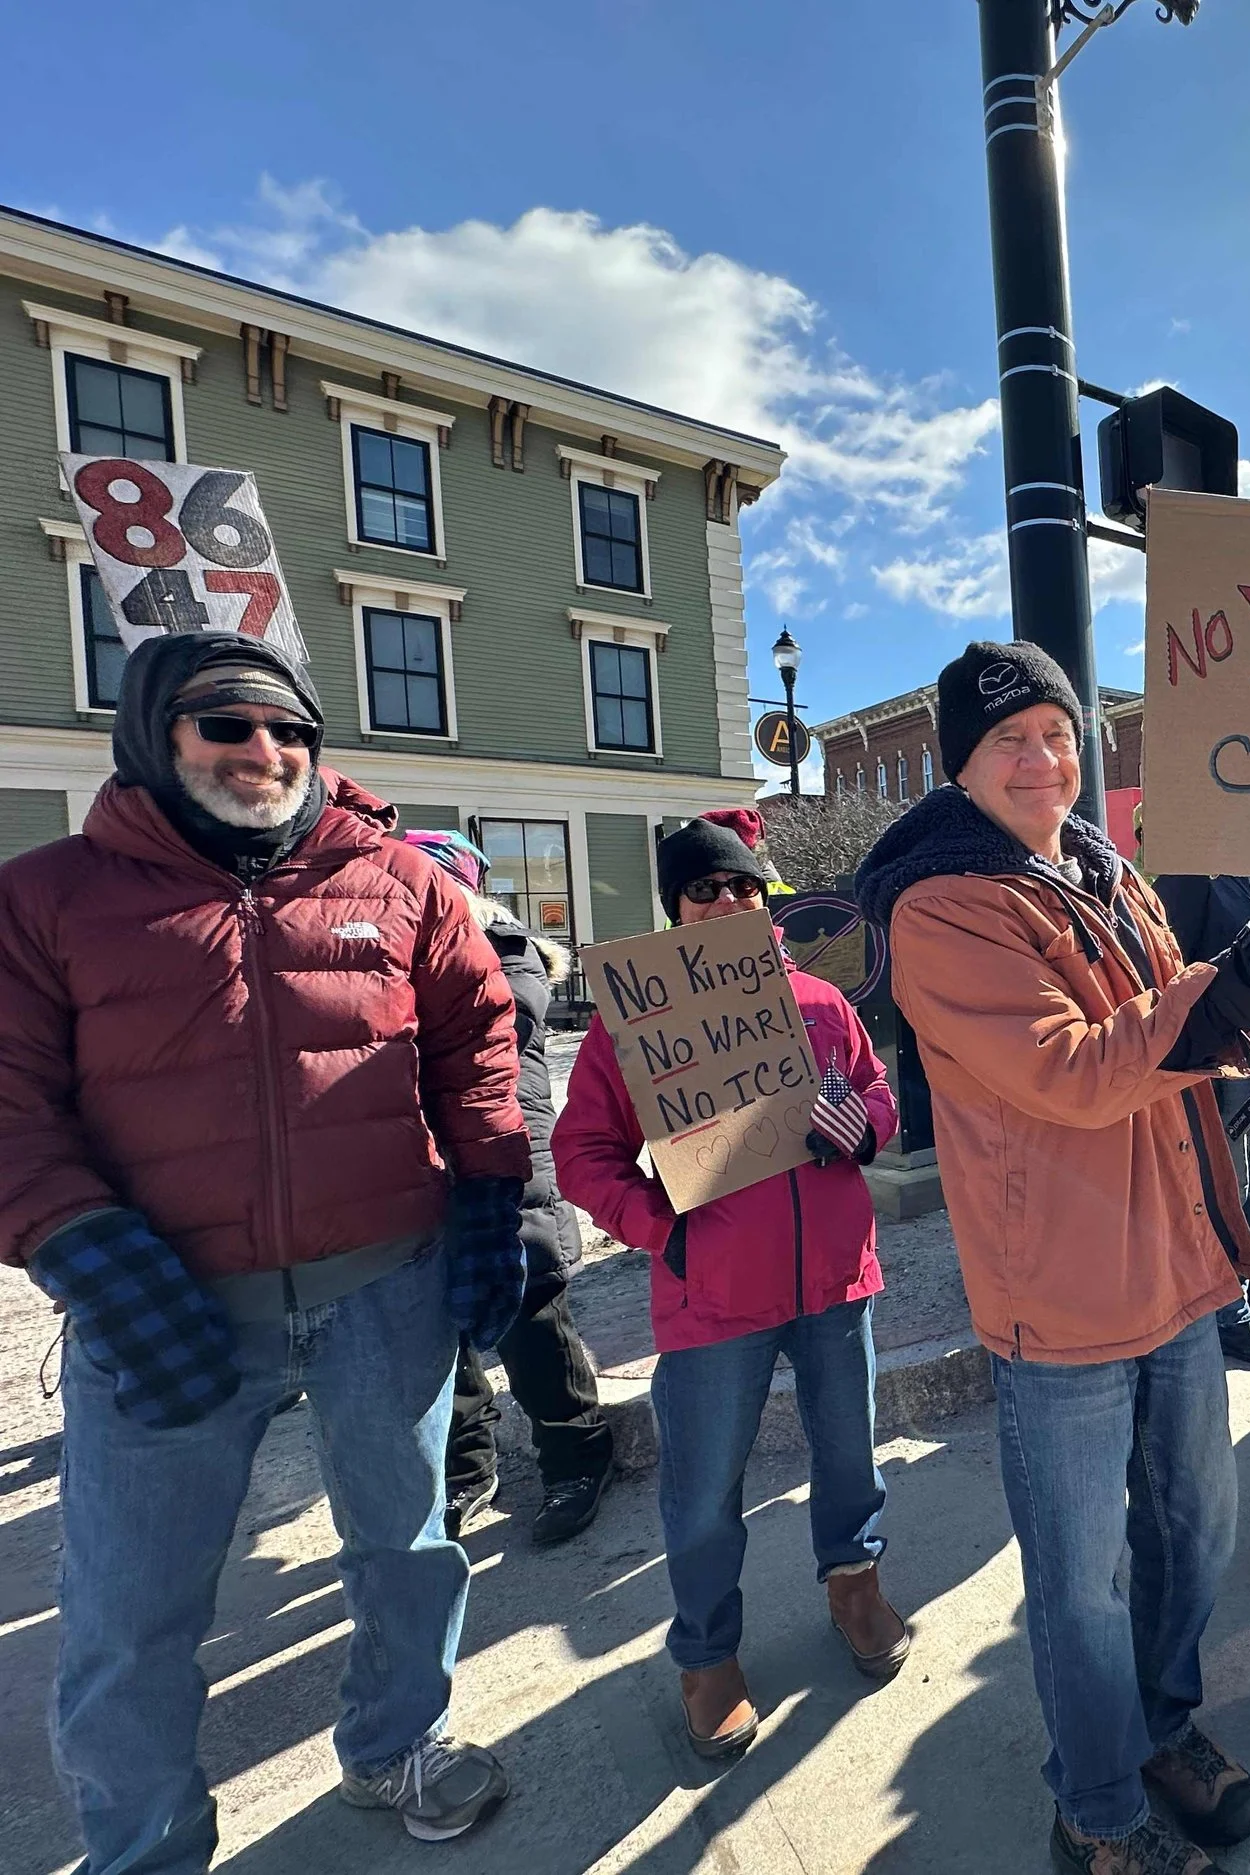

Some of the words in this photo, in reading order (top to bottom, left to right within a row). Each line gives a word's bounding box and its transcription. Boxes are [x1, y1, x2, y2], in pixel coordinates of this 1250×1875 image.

[74, 459, 271, 568] 86
[120, 569, 282, 640] 47
[1165, 607, 1234, 686] NO
[677, 934, 786, 995] Kings!
[701, 996, 796, 1054] WAR!
[723, 1046, 815, 1113] ICE!
